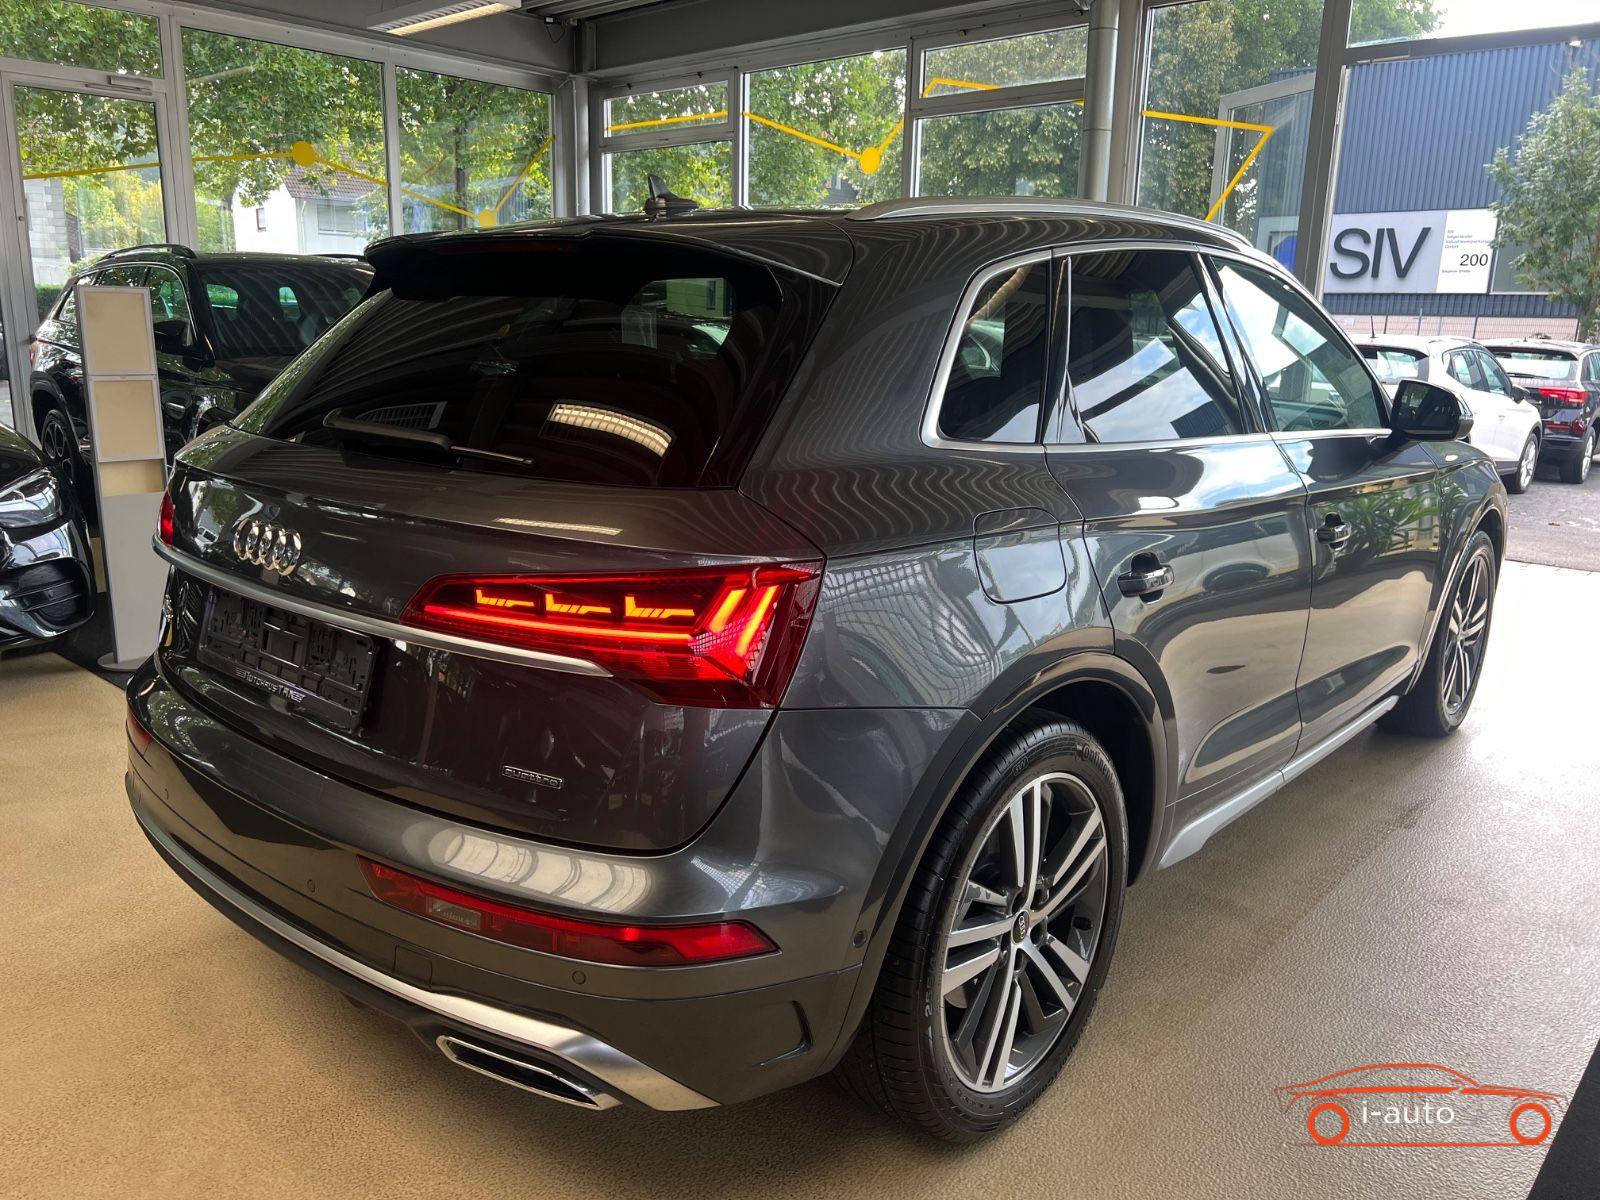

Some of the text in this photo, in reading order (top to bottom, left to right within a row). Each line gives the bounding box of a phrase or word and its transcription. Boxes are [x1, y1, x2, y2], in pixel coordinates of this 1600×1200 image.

[1330, 227, 1432, 279] SIV
[1459, 253, 1489, 267] 200
[504, 768, 559, 786] quattro
